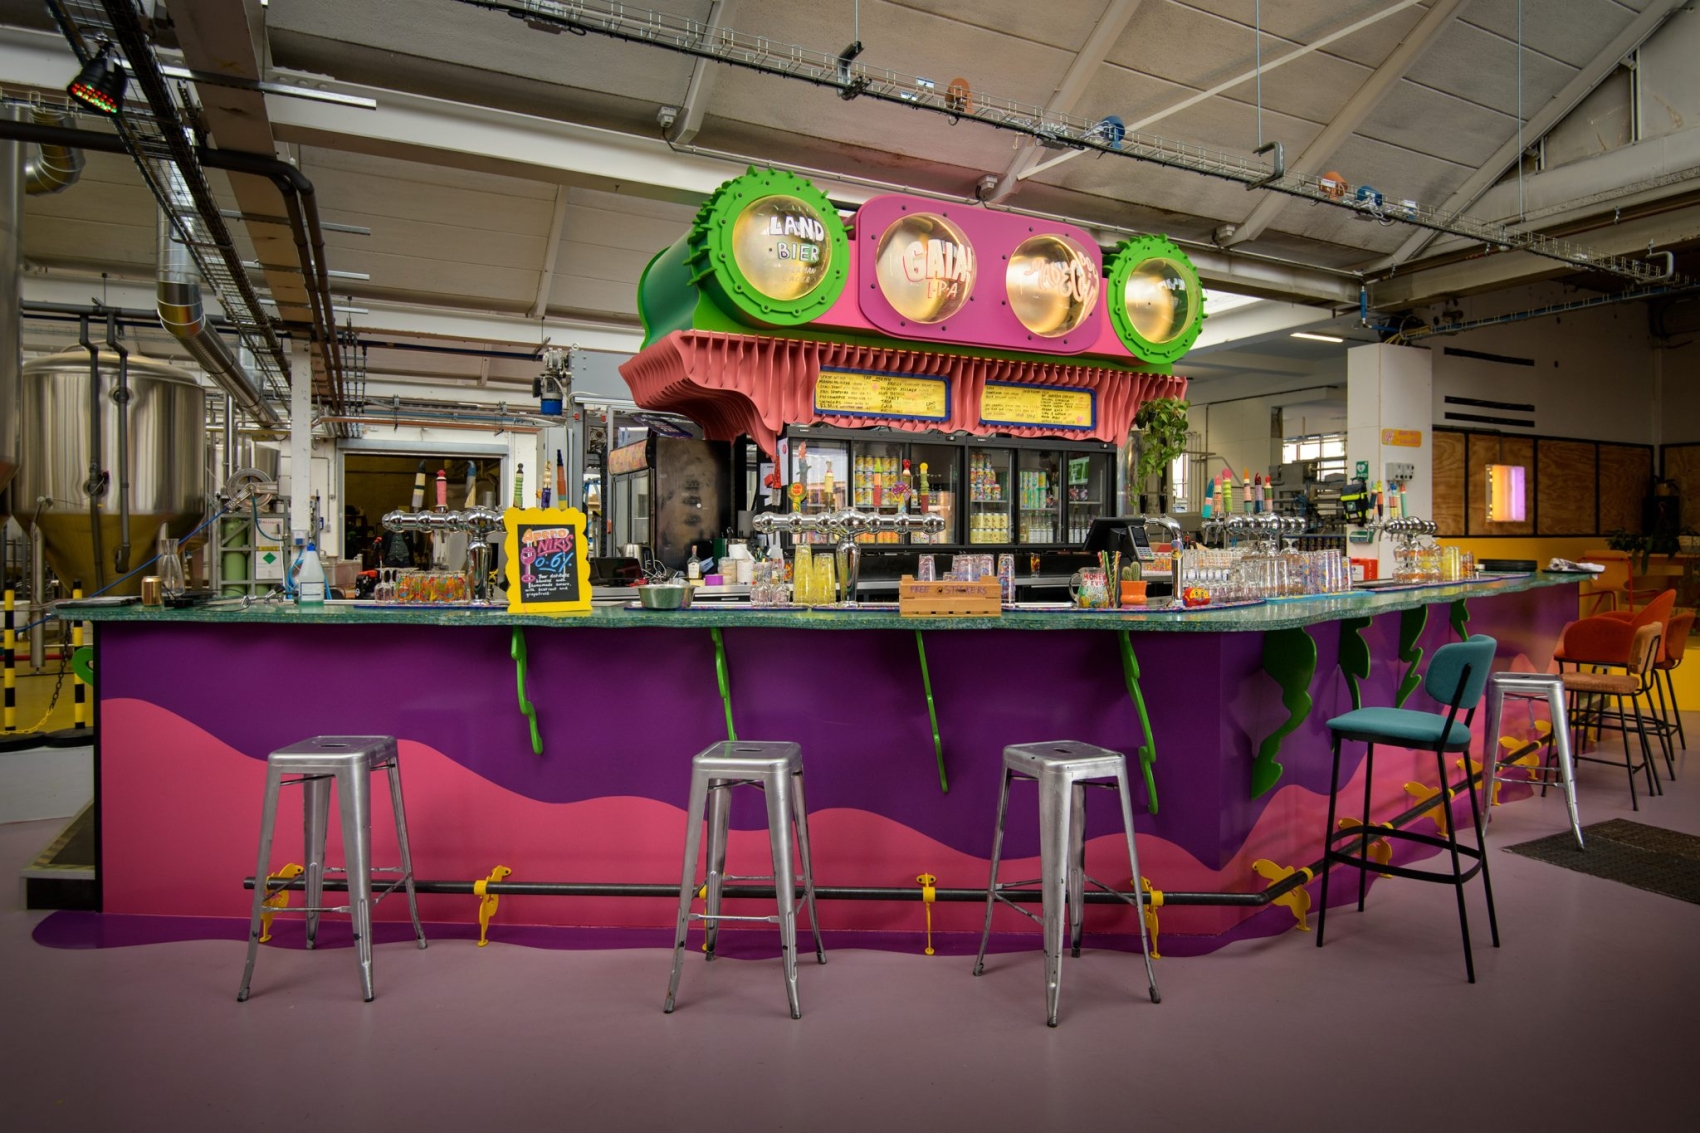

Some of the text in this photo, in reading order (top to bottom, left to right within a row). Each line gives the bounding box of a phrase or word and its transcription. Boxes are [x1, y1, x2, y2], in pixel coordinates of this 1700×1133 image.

[769, 216, 825, 242] LAND
[777, 242, 820, 262] BIER
[522, 528, 569, 547] Apero
[537, 534, 573, 556] NIKS
[909, 585, 987, 595] FREE STICKERS
